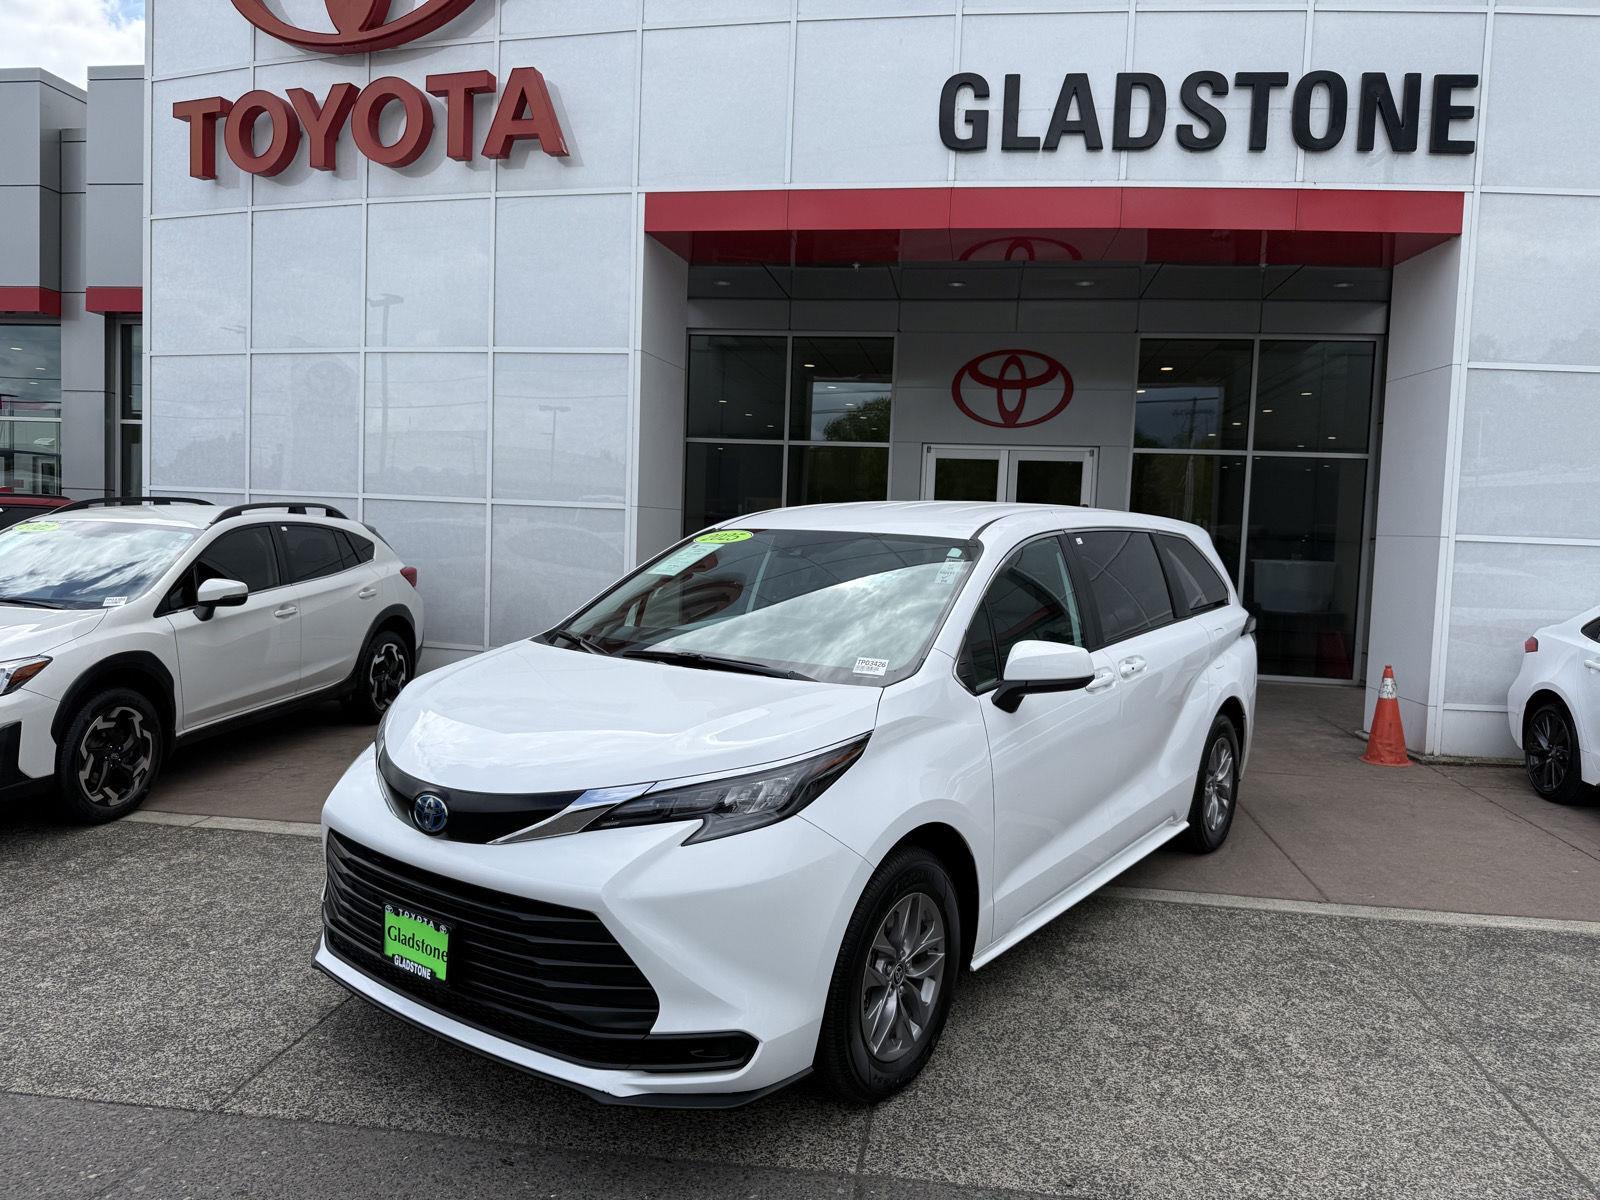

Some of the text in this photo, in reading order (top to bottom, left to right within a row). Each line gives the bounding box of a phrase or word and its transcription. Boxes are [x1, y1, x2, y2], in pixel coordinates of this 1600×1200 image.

[172, 66, 570, 181] TOYOTA
[938, 70, 1479, 155] GLADSTONE
[398, 908, 435, 929] TOYOTA
[387, 925, 448, 963] Gladstone
[394, 954, 432, 980] GLADSTONE
